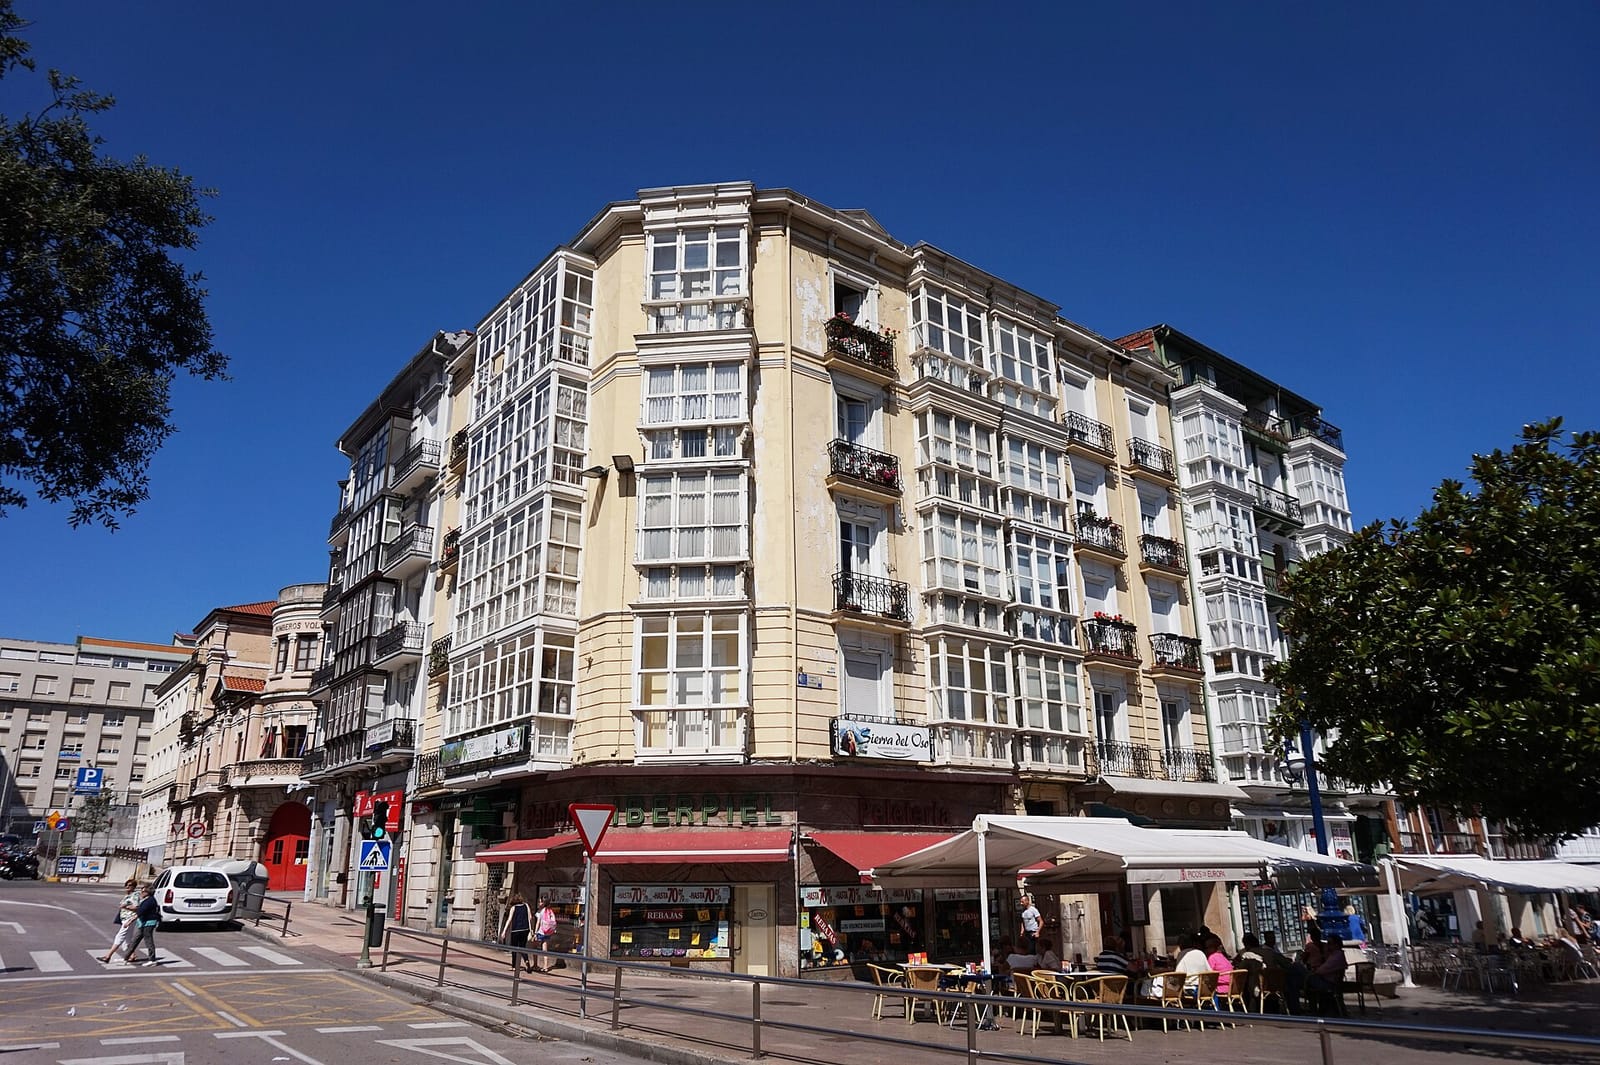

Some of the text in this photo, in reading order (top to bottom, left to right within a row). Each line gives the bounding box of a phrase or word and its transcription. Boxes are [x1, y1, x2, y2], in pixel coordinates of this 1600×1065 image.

[304, 621, 321, 629] VOL
[856, 727, 893, 746] Sierra
[895, 733, 909, 747] del
[911, 733, 929, 748] Oso
[84, 769, 97, 782] P
[612, 793, 782, 826] IBERPIEL
[1187, 870, 1202, 878] PICOS
[1207, 870, 1226, 878] EUROPA
[647, 911, 683, 919] REBAJAS
[814, 914, 837, 945] REBAJAS
